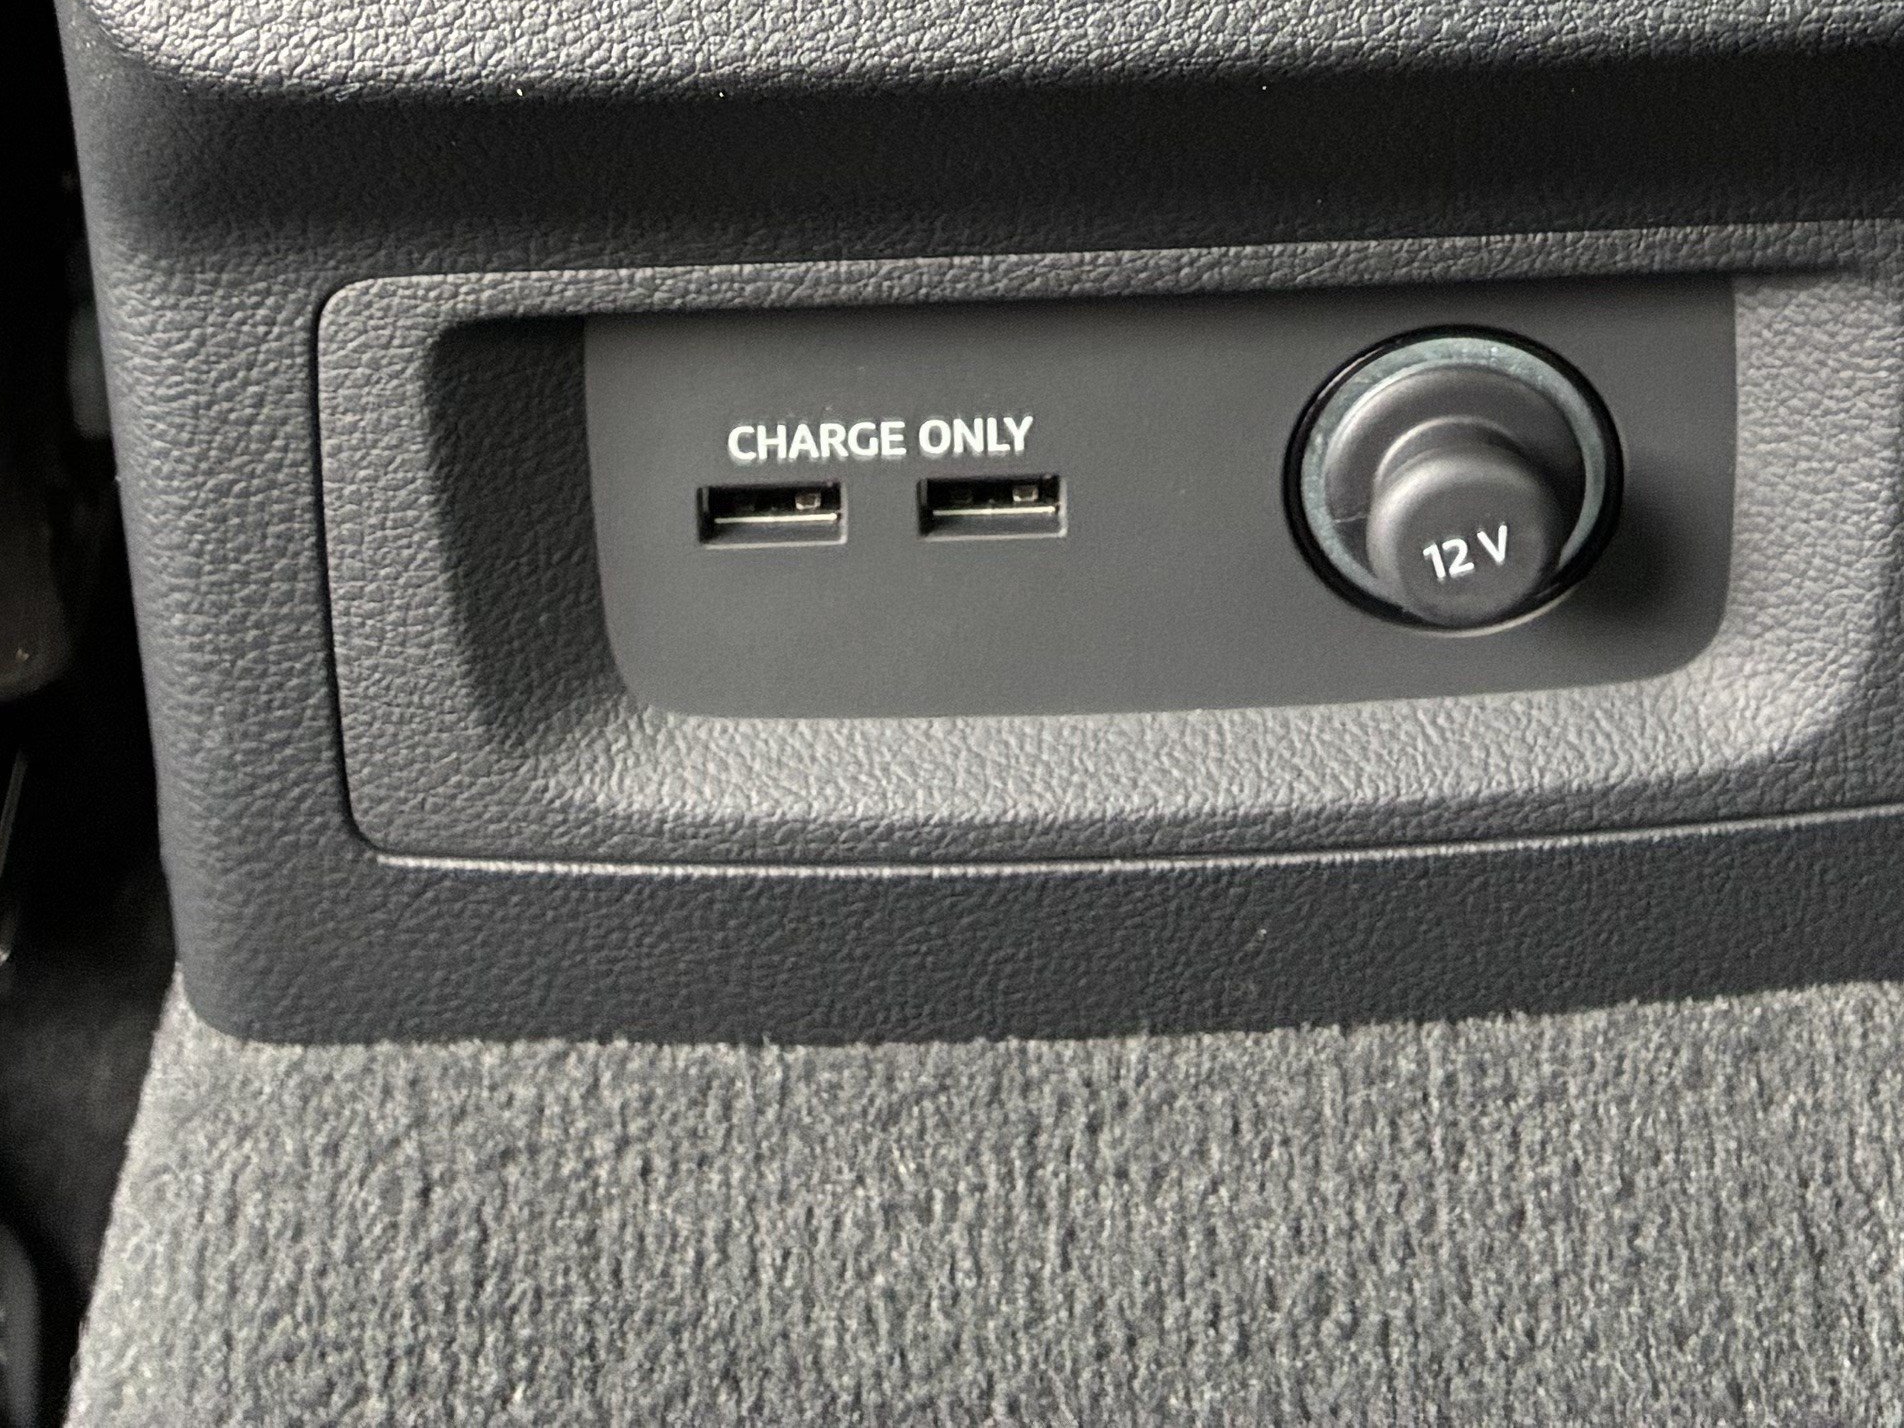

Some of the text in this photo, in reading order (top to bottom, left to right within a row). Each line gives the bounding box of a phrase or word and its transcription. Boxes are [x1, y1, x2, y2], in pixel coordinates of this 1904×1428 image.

[727, 414, 1034, 465] CHARGE ONLY
[1422, 524, 1508, 582] 12 V
